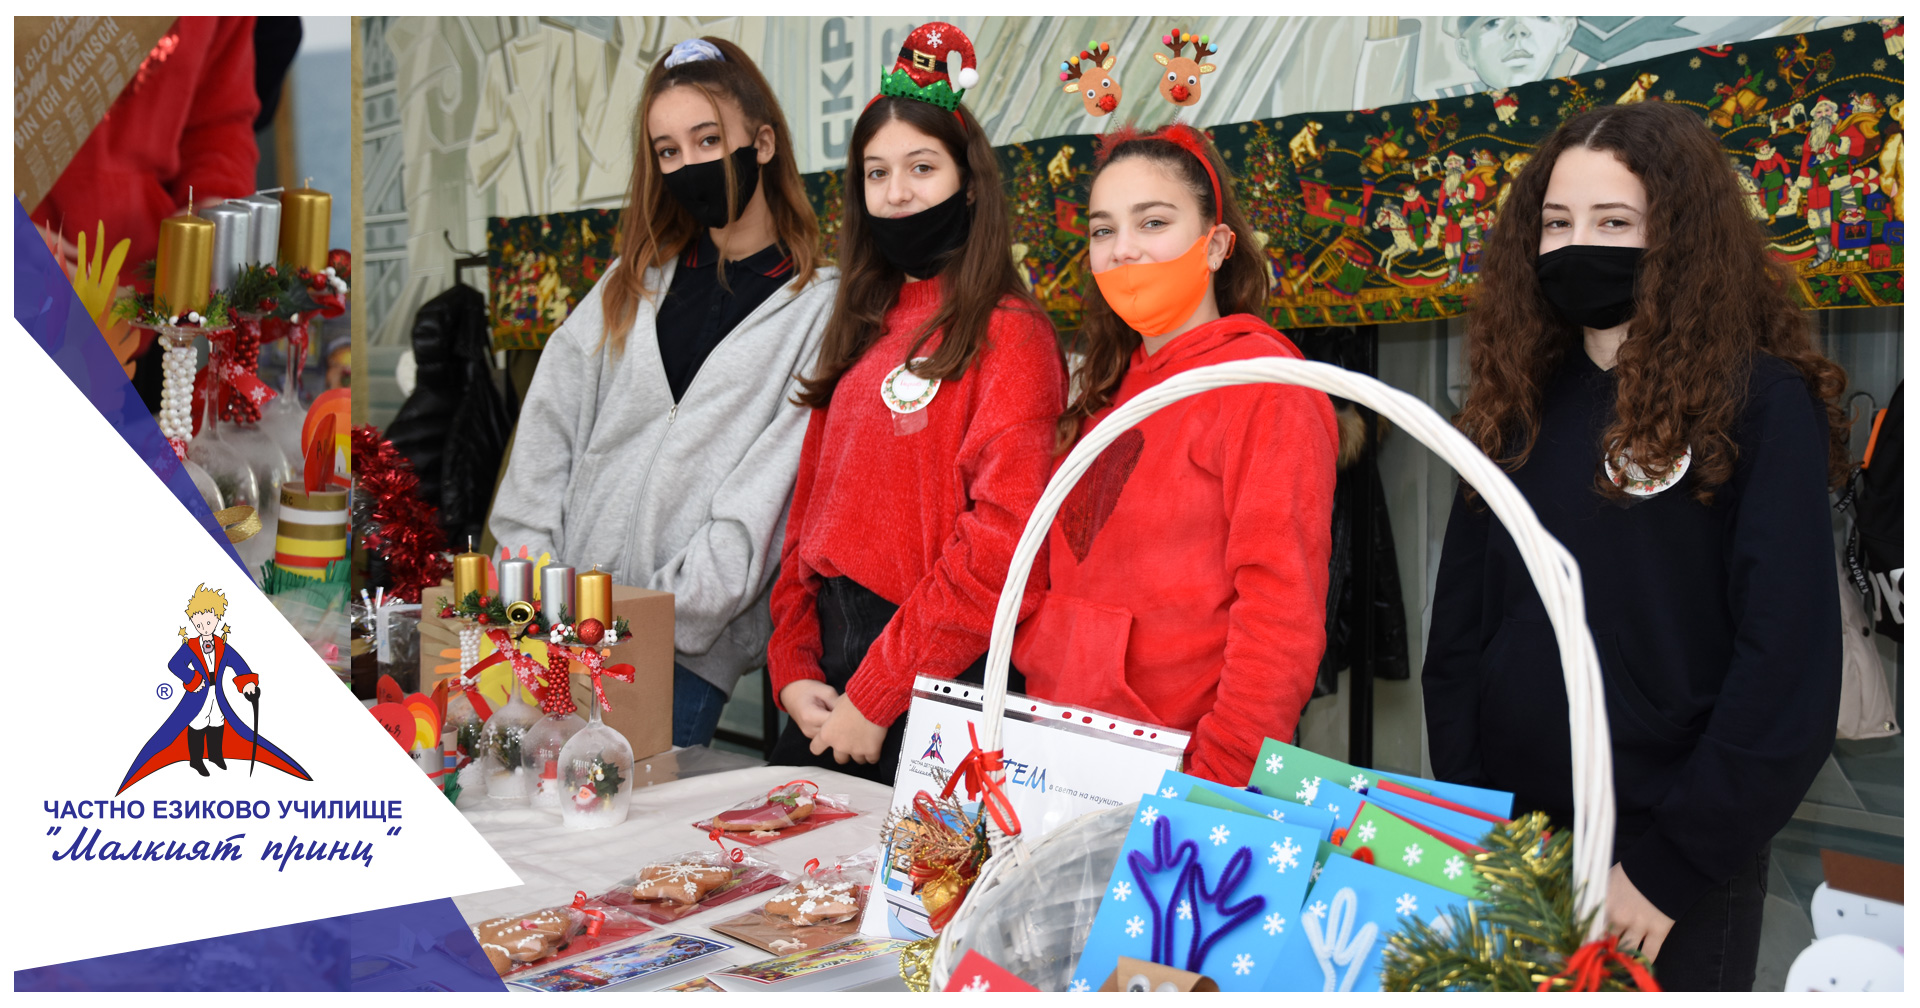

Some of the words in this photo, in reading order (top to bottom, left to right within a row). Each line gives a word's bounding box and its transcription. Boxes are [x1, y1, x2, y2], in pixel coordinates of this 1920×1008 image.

[36, 84, 62, 119] ICH
[58, 16, 120, 91] MENSCH
[822, 16, 853, 169] СКР
[1054, 785, 1078, 797] света
[1079, 791, 1089, 799] на
